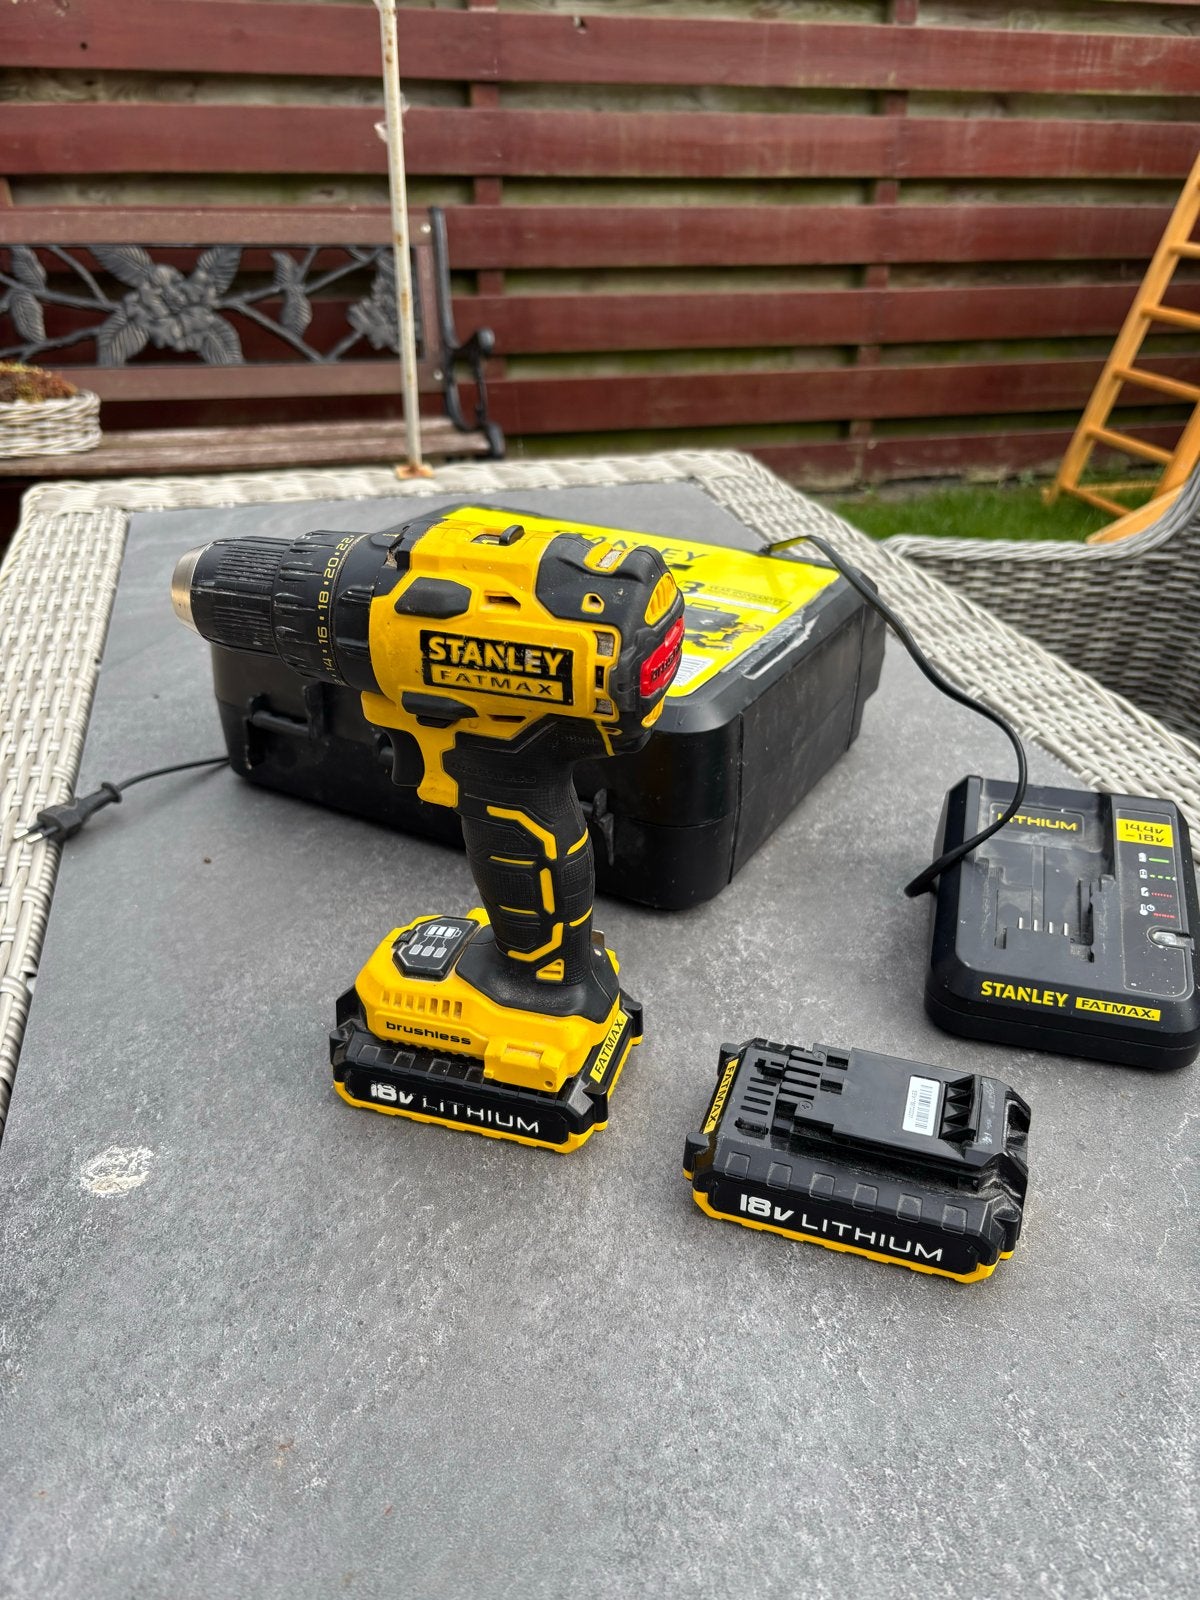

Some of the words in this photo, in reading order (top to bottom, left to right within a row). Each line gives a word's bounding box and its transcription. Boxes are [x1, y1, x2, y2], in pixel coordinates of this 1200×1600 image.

[336, 537, 354, 551] 22
[324, 557, 339, 579] 20
[318, 590, 330, 610] 18
[318, 626, 329, 644] 16
[428, 636, 565, 676] STANLEY
[440, 670, 554, 696] FATMAX
[981, 981, 1069, 1008] STANLEY
[386, 1021, 471, 1045] brushless
[595, 1019, 624, 1075] FATMAX
[708, 1066, 735, 1123] FATMAX
[423, 1097, 539, 1134] LITHIUM
[802, 1213, 943, 1262] LITHIUM
